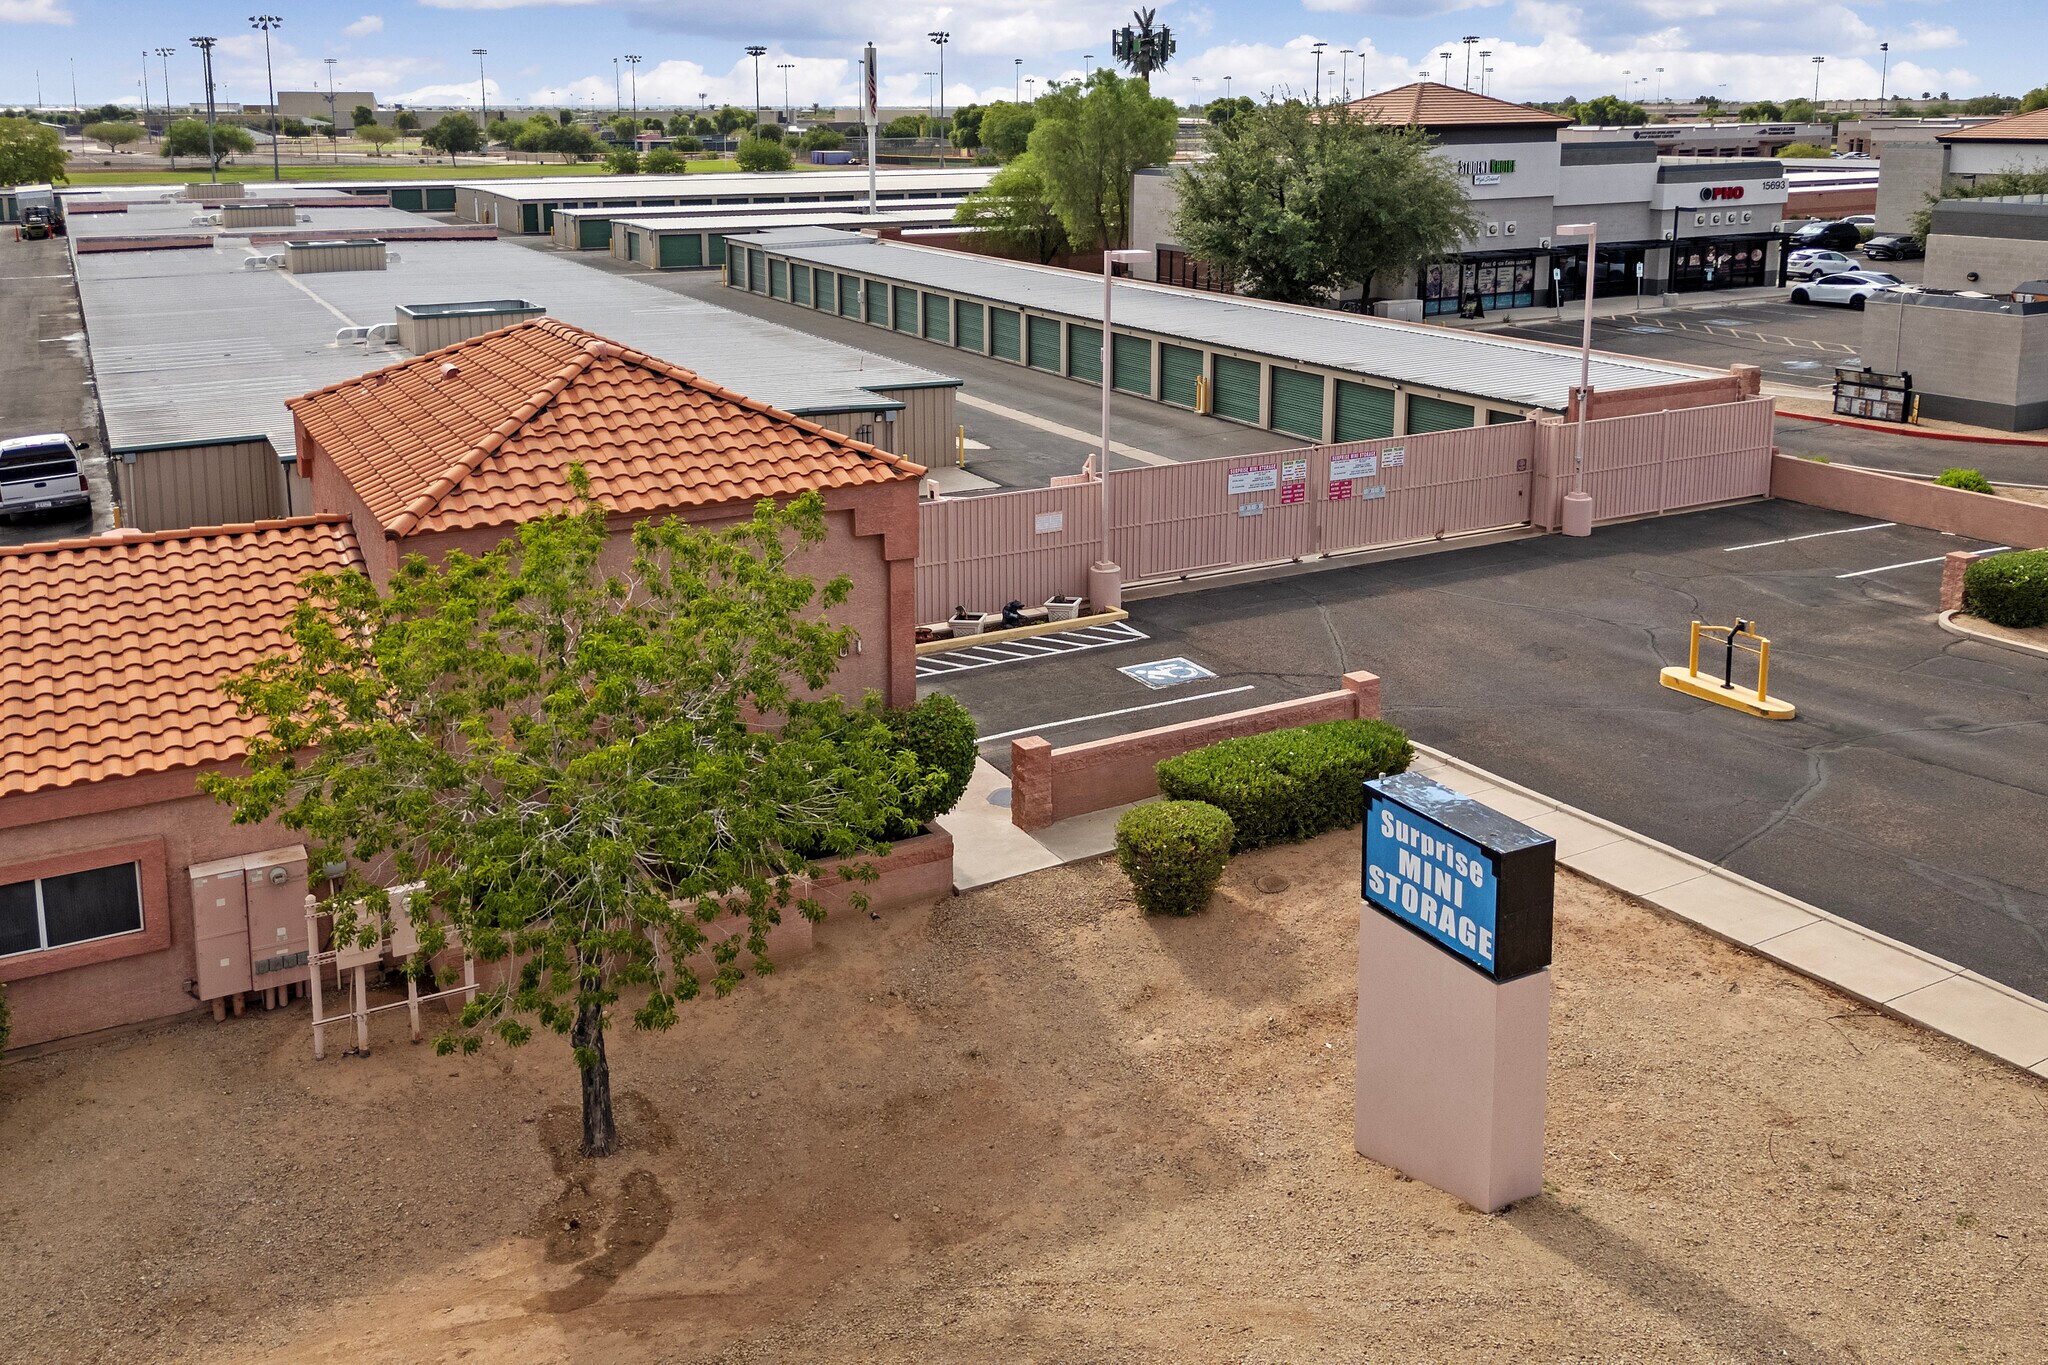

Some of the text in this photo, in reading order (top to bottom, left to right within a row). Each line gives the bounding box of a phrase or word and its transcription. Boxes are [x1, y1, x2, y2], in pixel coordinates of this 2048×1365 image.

[1458, 159, 1516, 175] STUDENT CHOICE
[1762, 180, 1786, 190] 15693
[1712, 186, 1744, 200] PHO
[1381, 809, 1483, 888] Surprise
[1399, 848, 1463, 908] MINI
[1368, 864, 1492, 960] STORAGE
